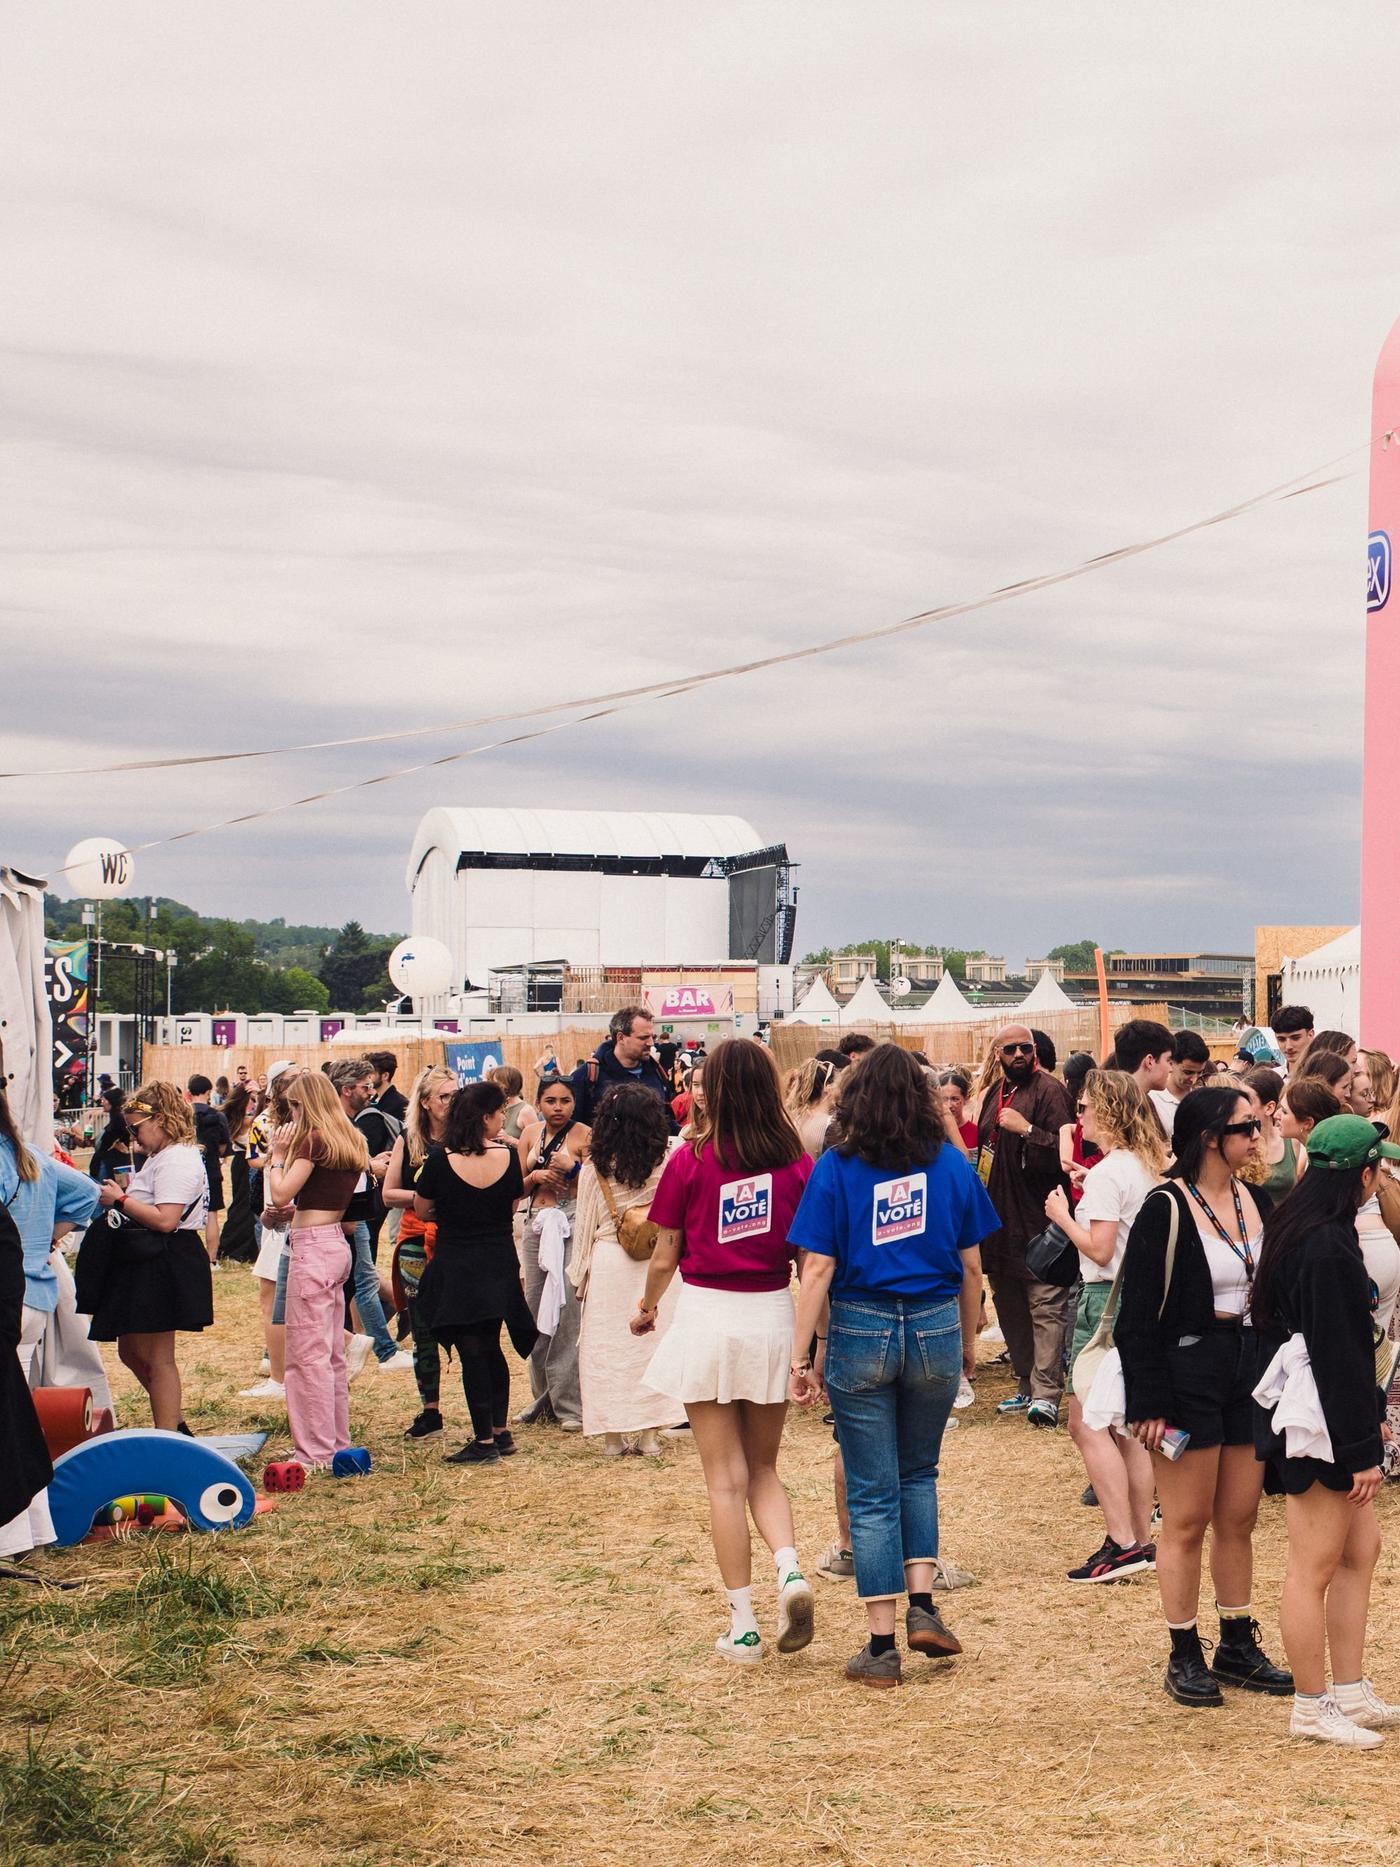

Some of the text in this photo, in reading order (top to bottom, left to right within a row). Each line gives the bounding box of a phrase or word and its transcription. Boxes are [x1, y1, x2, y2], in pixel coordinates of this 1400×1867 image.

[100, 853, 128, 884] WC
[666, 990, 710, 1008] BAR
[456, 1054, 476, 1071] Point
[738, 1184, 755, 1202] A
[892, 1184, 909, 1202] A
[724, 1199, 768, 1223] VOTÉ
[878, 1199, 923, 1224] VOTÉ
